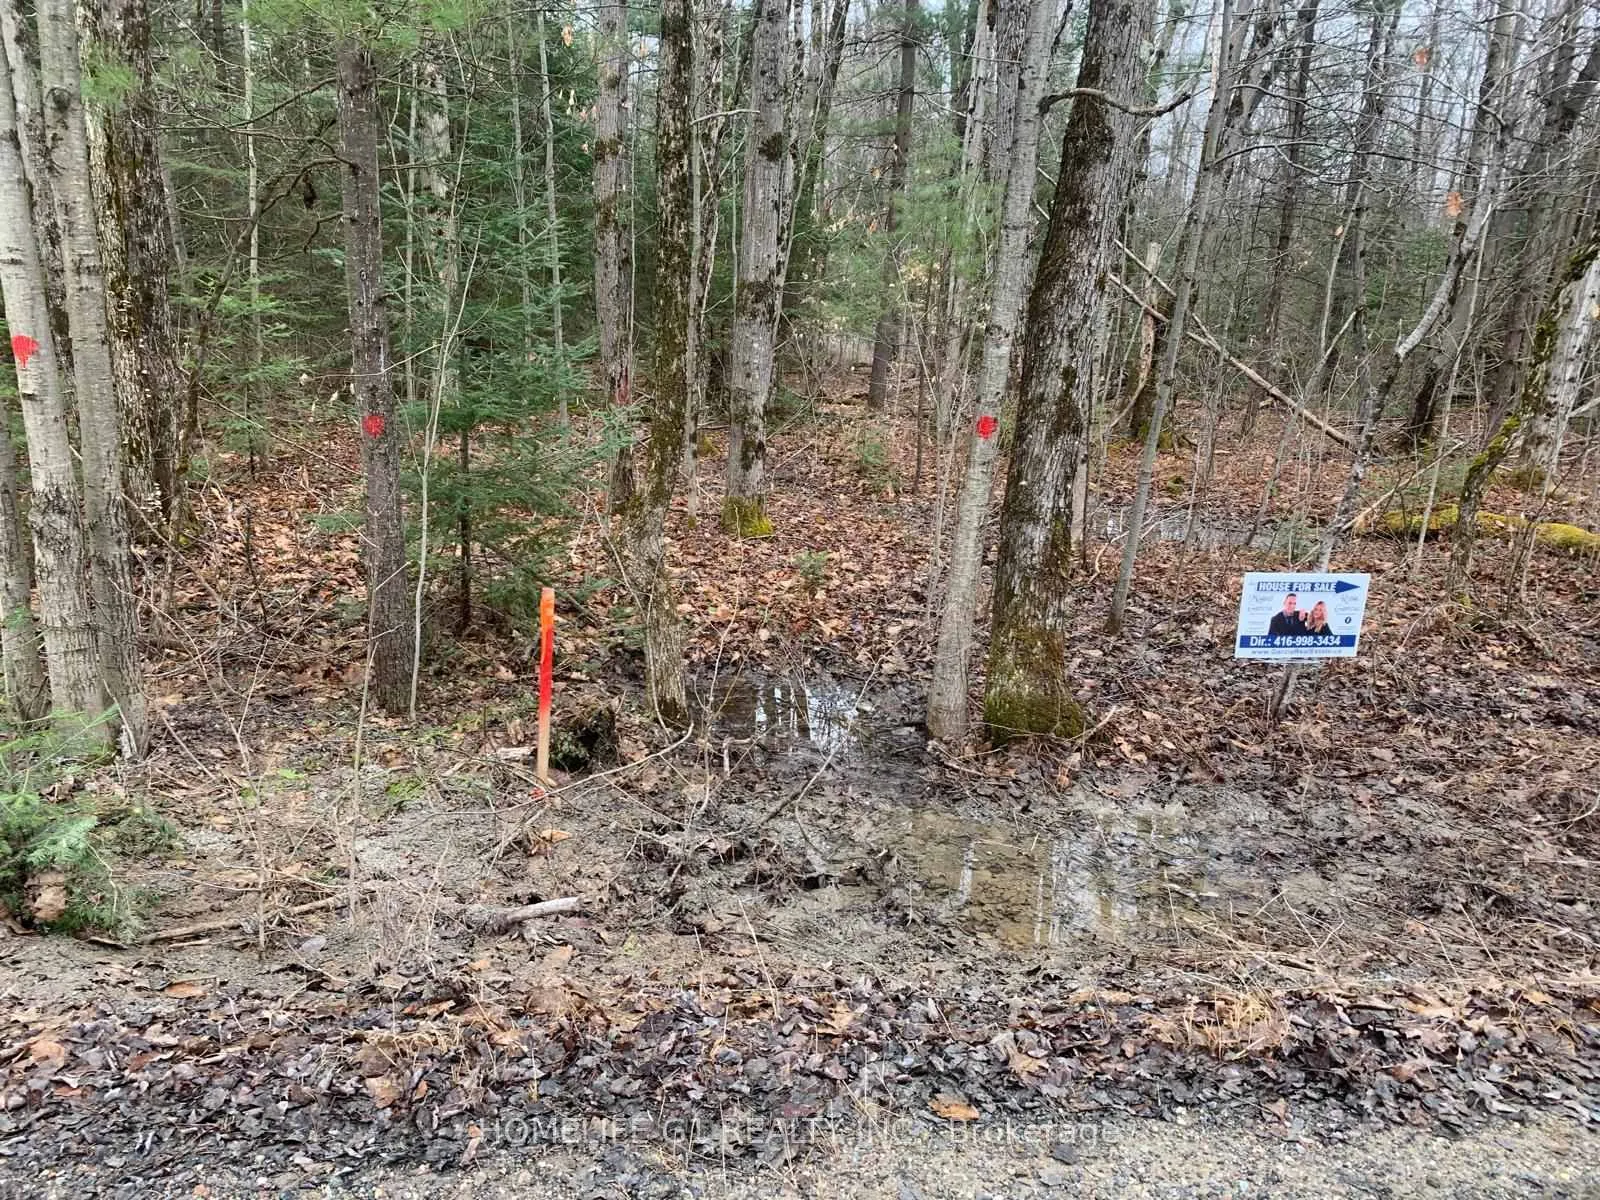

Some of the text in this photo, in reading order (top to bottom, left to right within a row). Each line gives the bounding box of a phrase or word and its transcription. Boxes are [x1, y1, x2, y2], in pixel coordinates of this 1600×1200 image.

[1258, 581, 1336, 593] HOUSE FOR SALE
[1273, 635, 1341, 646] 416-998-3434
